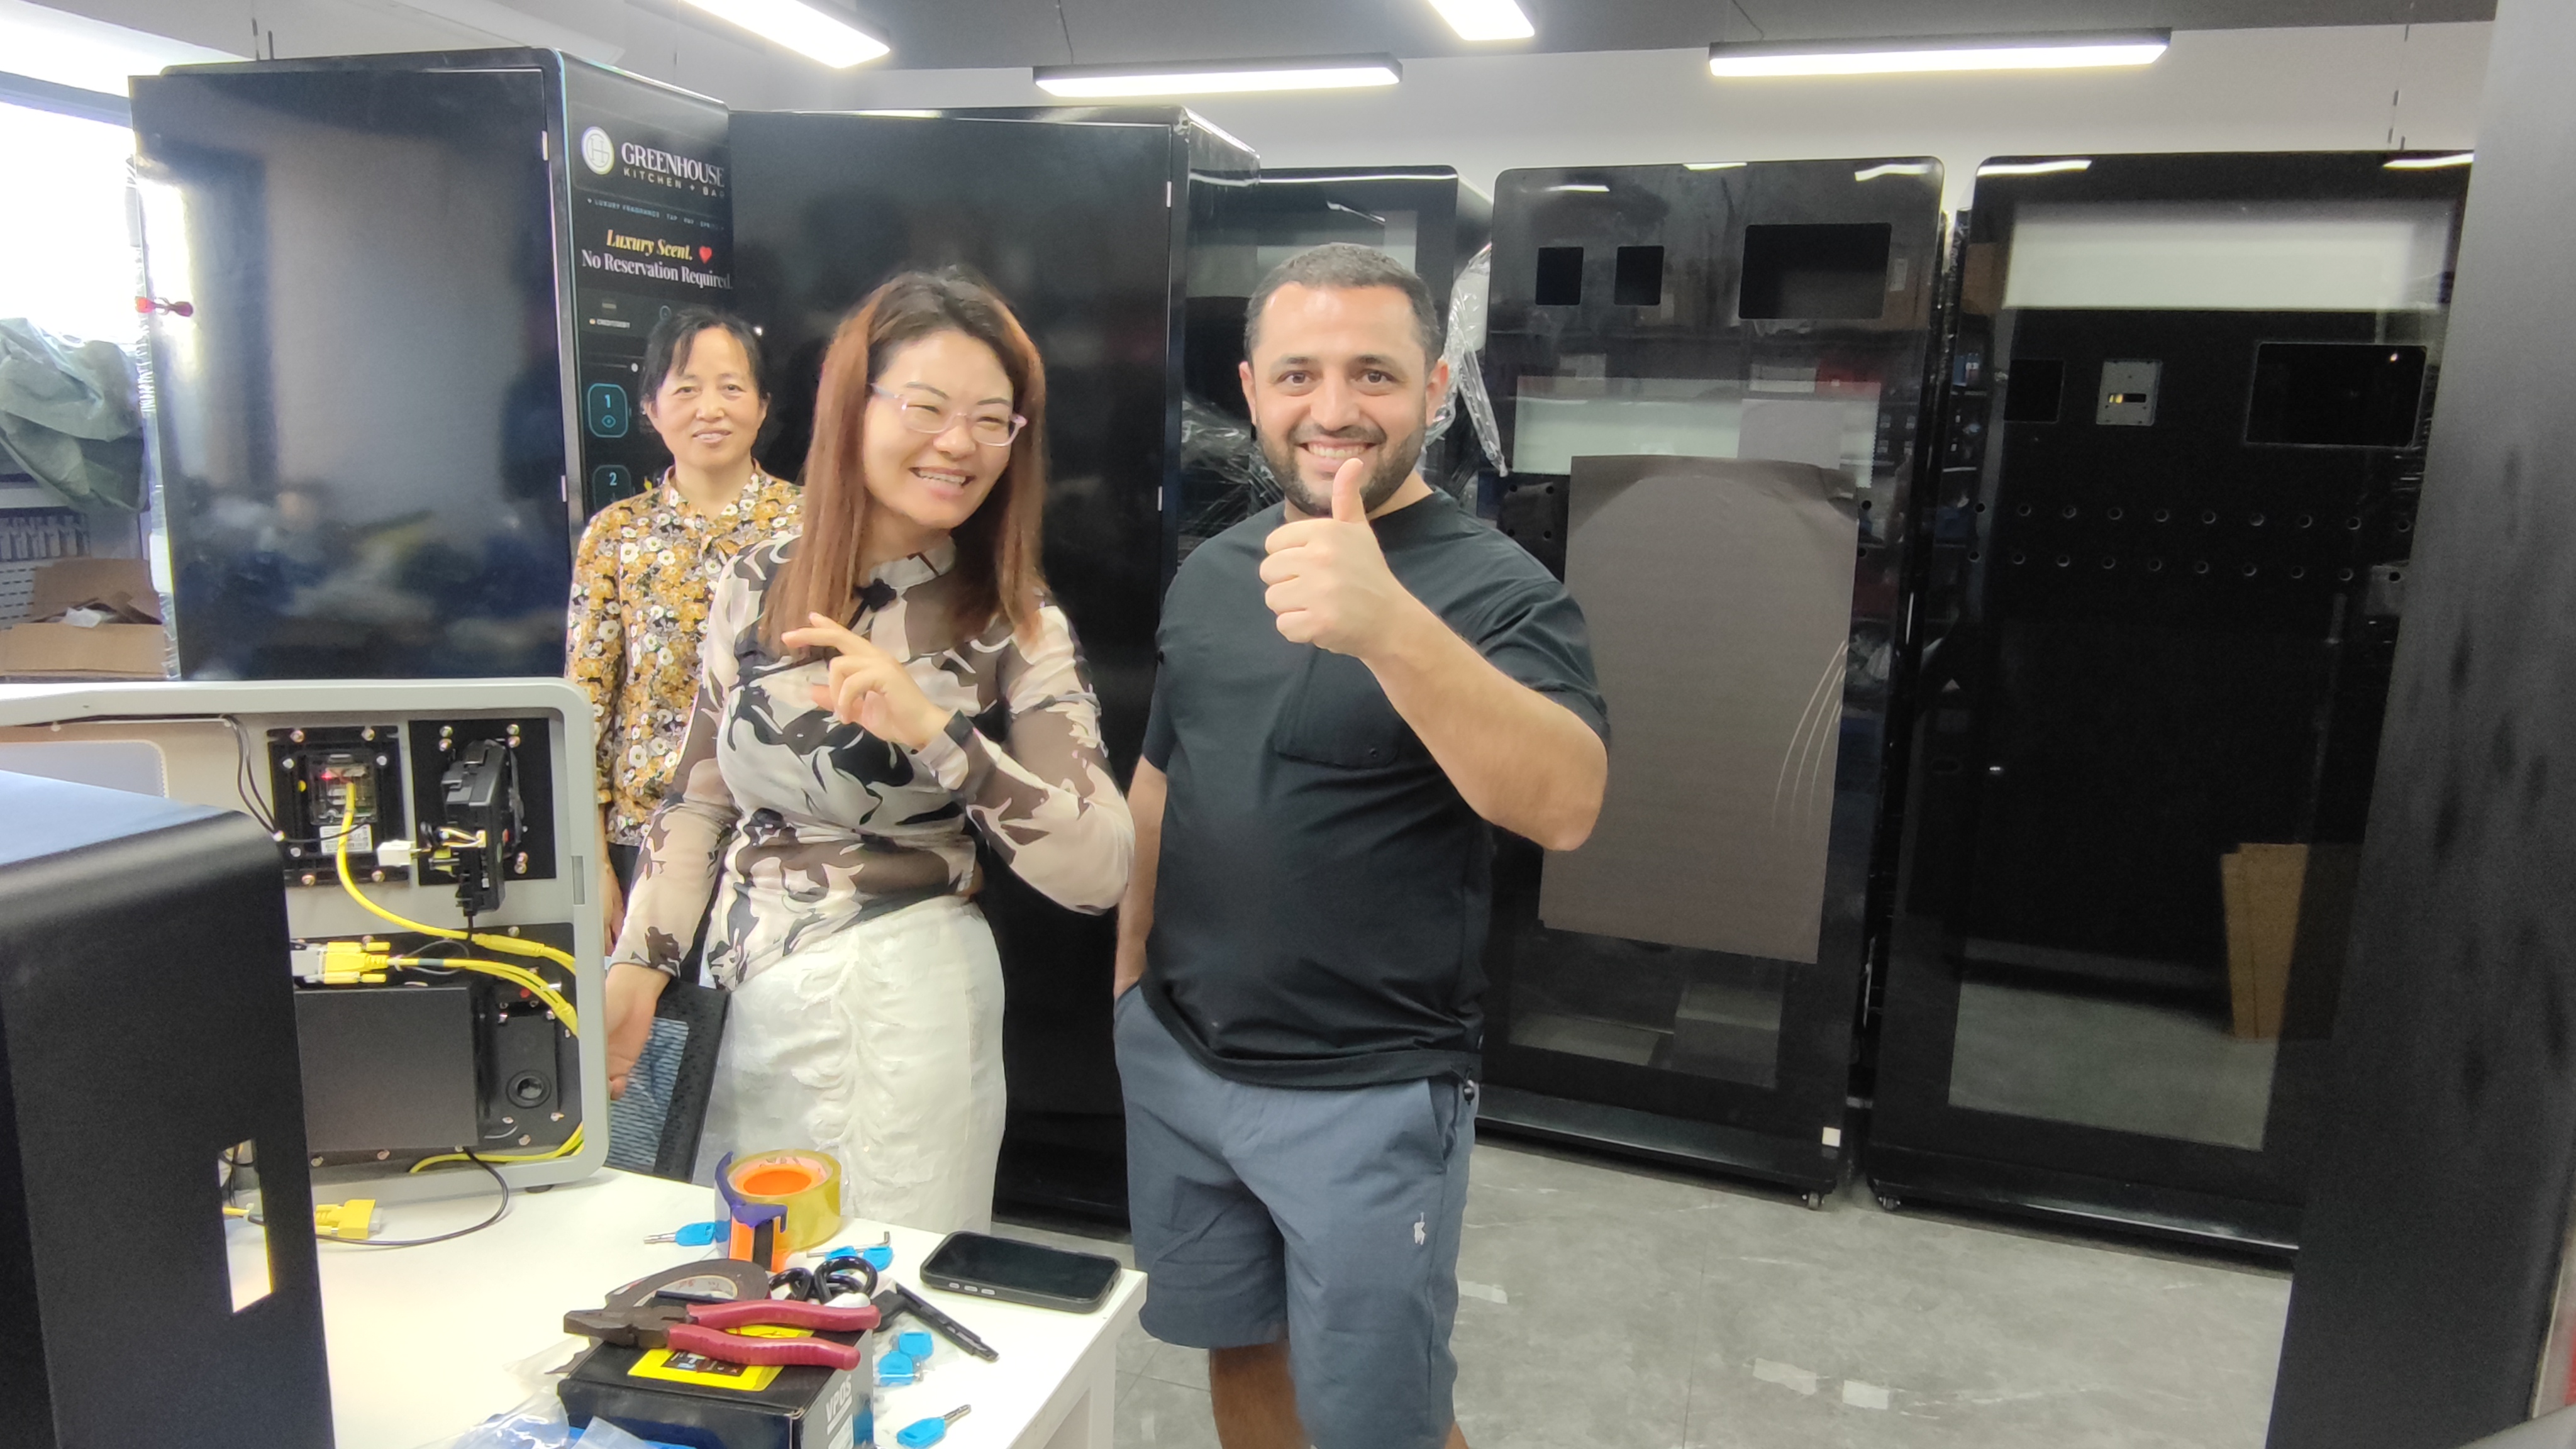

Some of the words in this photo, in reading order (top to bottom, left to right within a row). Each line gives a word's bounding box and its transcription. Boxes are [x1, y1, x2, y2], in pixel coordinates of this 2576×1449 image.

[621, 142, 724, 187] GREENHOUSE
[623, 167, 682, 189] KITCHEN
[606, 229, 655, 257] Luxury
[657, 238, 693, 261] Scent.
[582, 249, 601, 269] No
[604, 253, 679, 281] Reservation
[681, 265, 733, 290] Required.
[604, 394, 611, 408] 1
[609, 472, 618, 486] 2
[825, 1374, 852, 1423] VPOS
